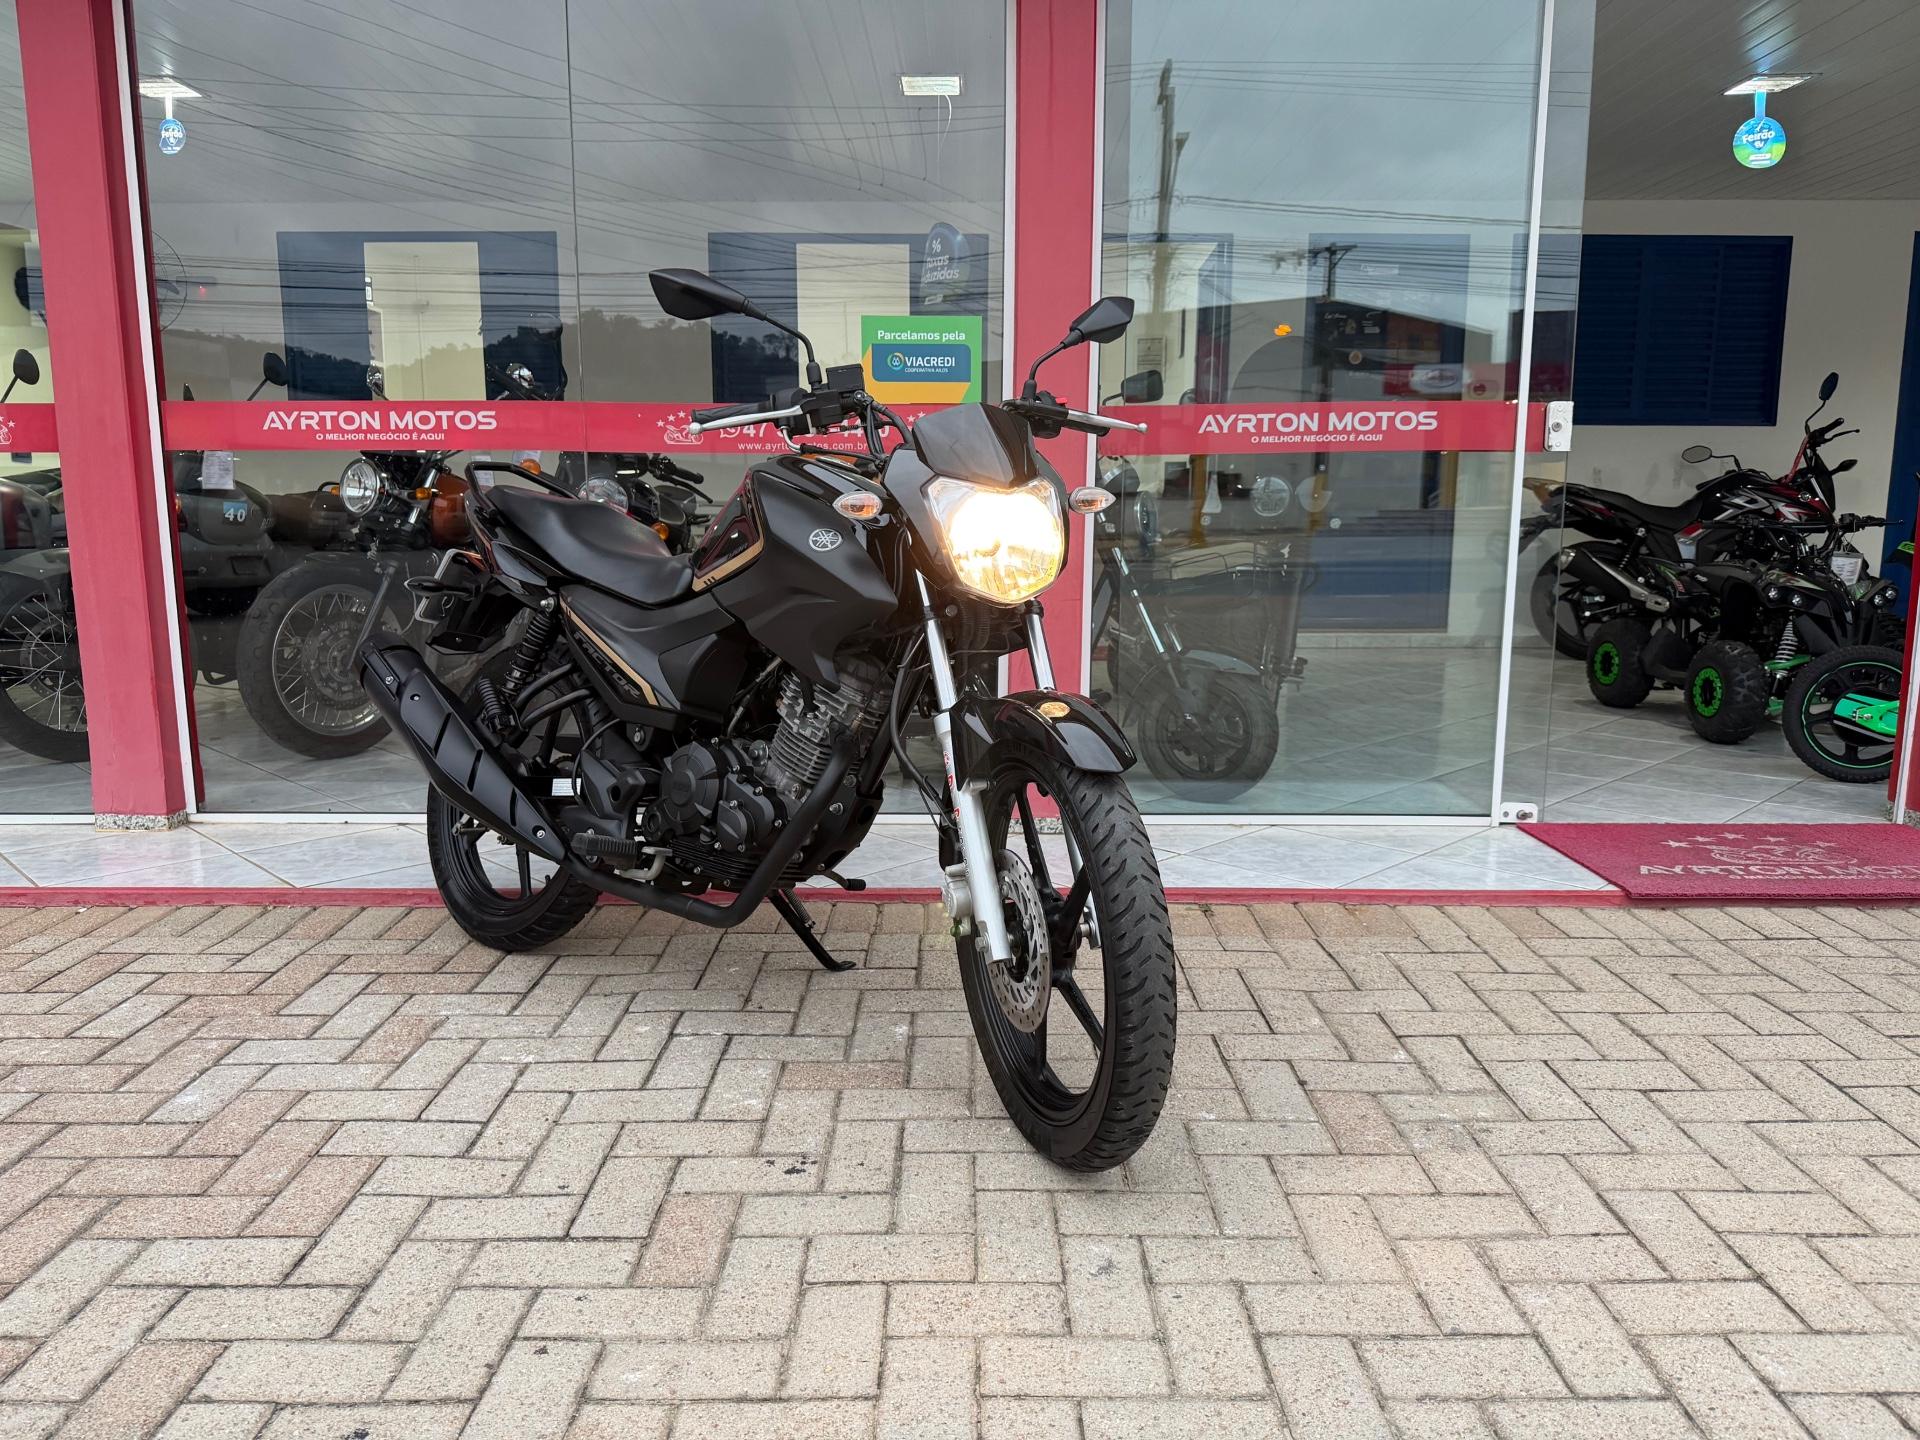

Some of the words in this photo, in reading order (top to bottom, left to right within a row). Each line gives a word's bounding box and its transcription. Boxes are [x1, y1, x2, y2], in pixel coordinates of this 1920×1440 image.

[1743, 129, 1776, 144] Feirão
[877, 330, 940, 340] Parcelamos
[942, 331, 966, 342] pela
[904, 356, 956, 367] VIACREDI
[263, 410, 380, 430] AYRTON
[390, 410, 497, 430] MOTOS
[1198, 412, 1319, 434] AYRTON
[1328, 411, 1438, 431] MOTOS
[366, 432, 410, 440] NEGÓCIO
[412, 432, 418, 440] É
[1260, 435, 1302, 443] MELHOR
[1303, 433, 1348, 442] NEGÓCIO
[1349, 433, 1356, 441] É
[224, 507, 246, 522] 40
